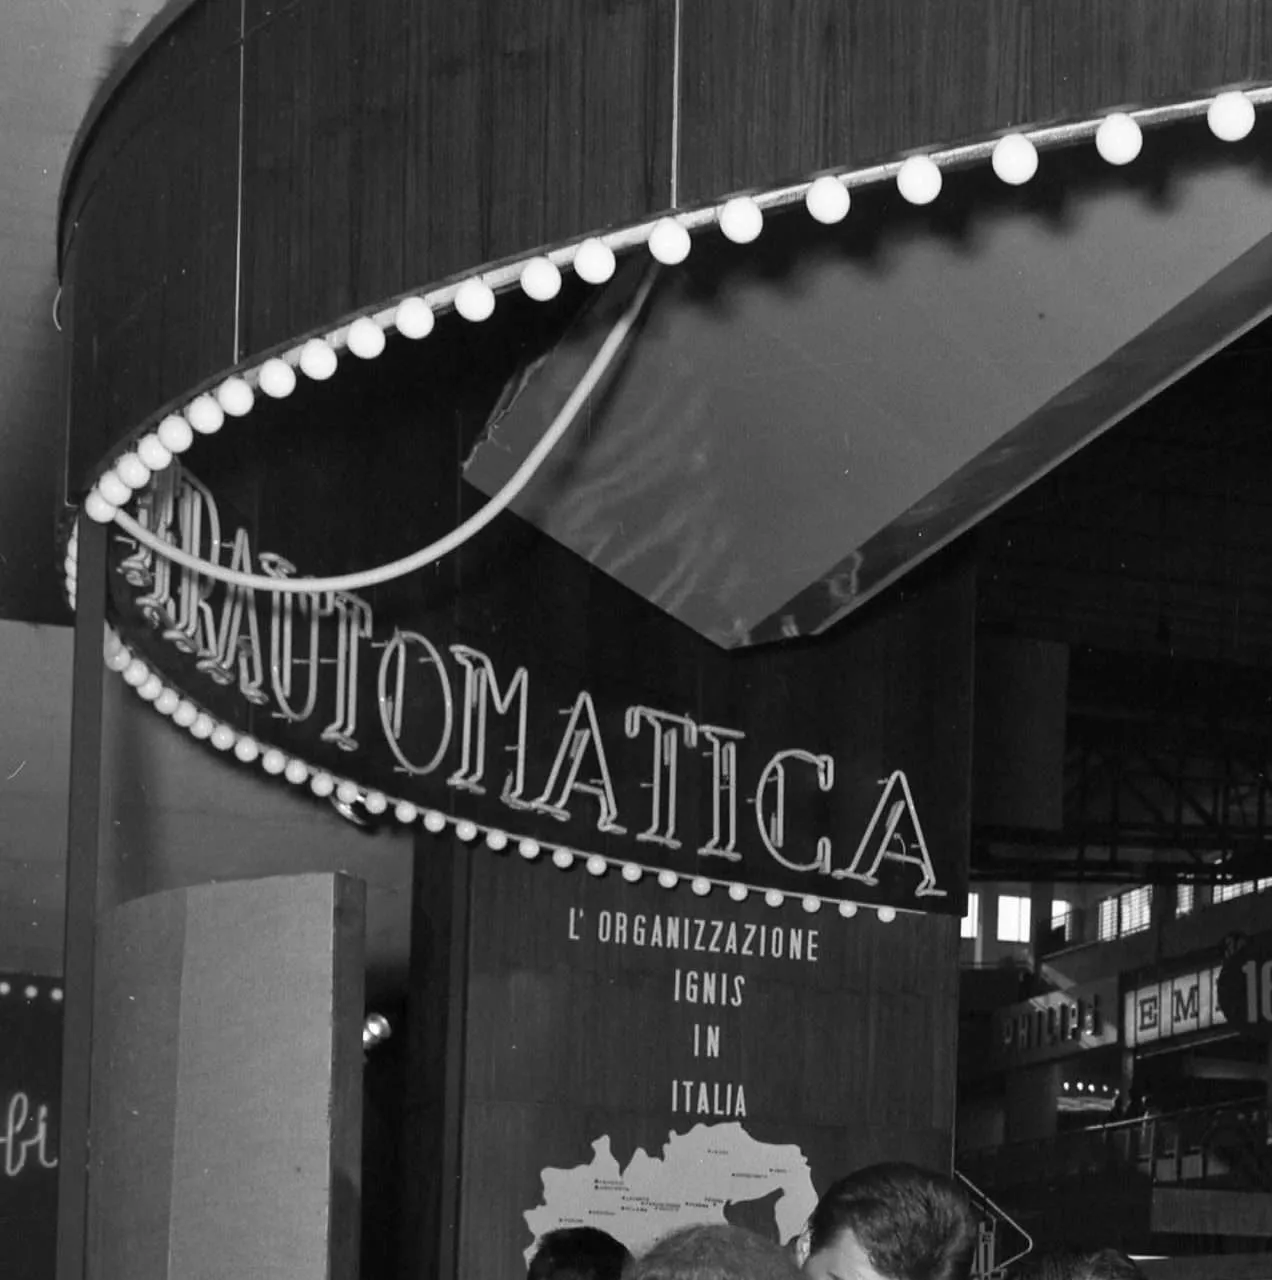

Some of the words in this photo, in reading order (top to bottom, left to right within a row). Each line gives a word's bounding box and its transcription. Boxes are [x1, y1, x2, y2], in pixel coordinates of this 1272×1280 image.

[598, 910, 819, 962] ORGANIZZAZIONE
[674, 968, 746, 1007] IGNIS
[693, 1023, 720, 1058] IN
[671, 1079, 748, 1117] ITALIA
